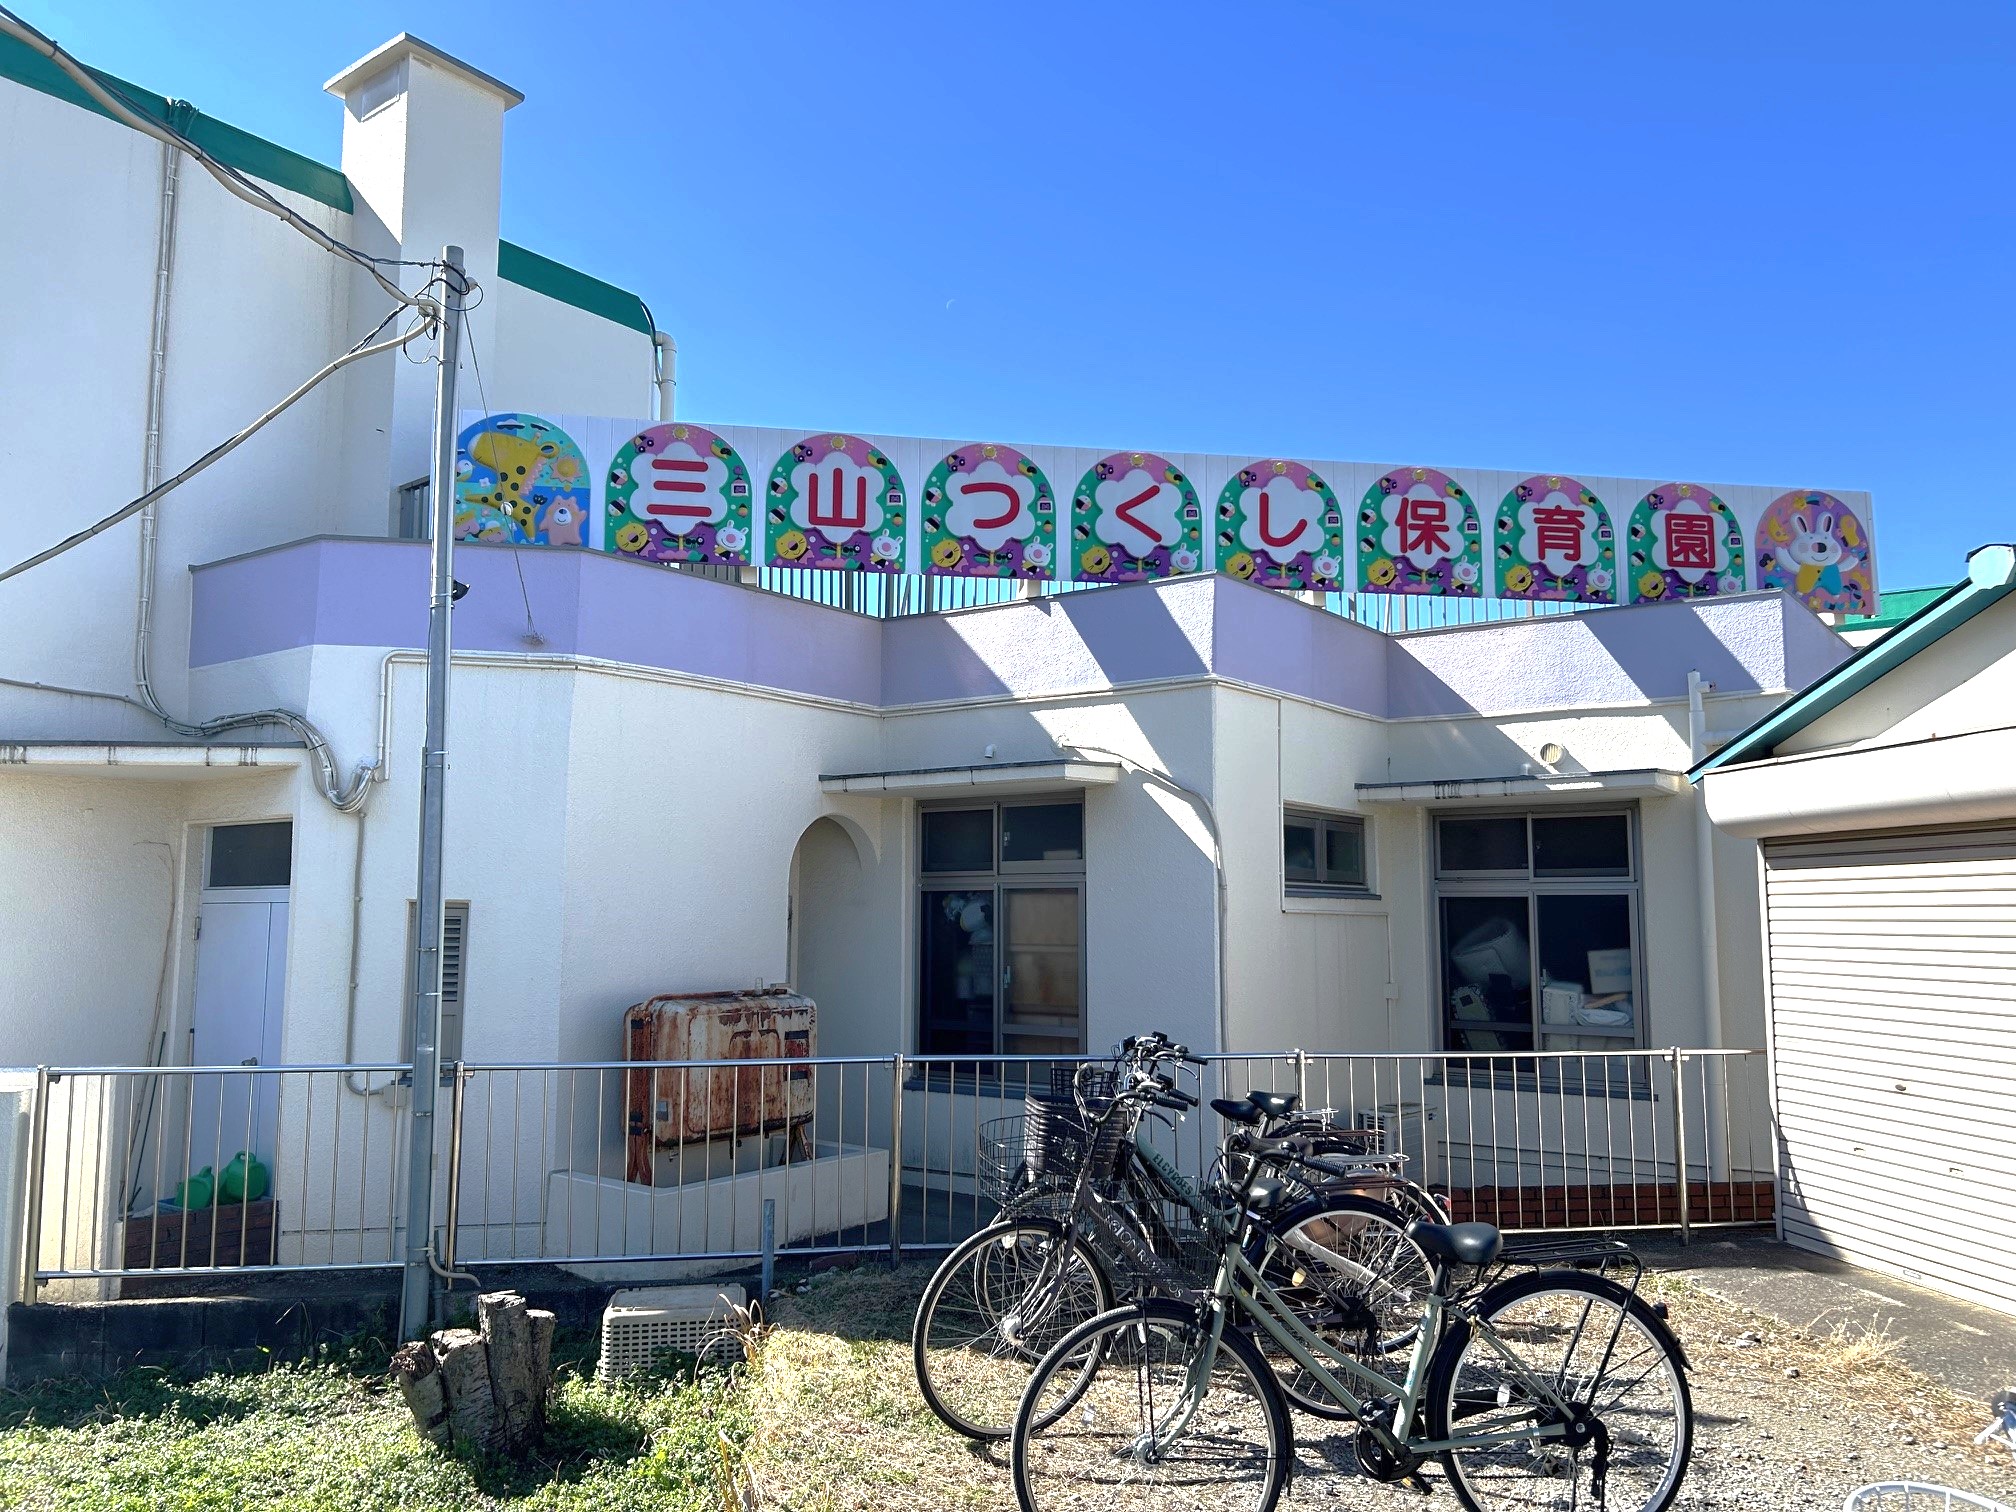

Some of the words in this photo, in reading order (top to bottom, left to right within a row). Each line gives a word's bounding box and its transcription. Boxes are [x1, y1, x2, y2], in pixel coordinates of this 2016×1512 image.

[647, 458, 1716, 569] 三山つくし保育園
